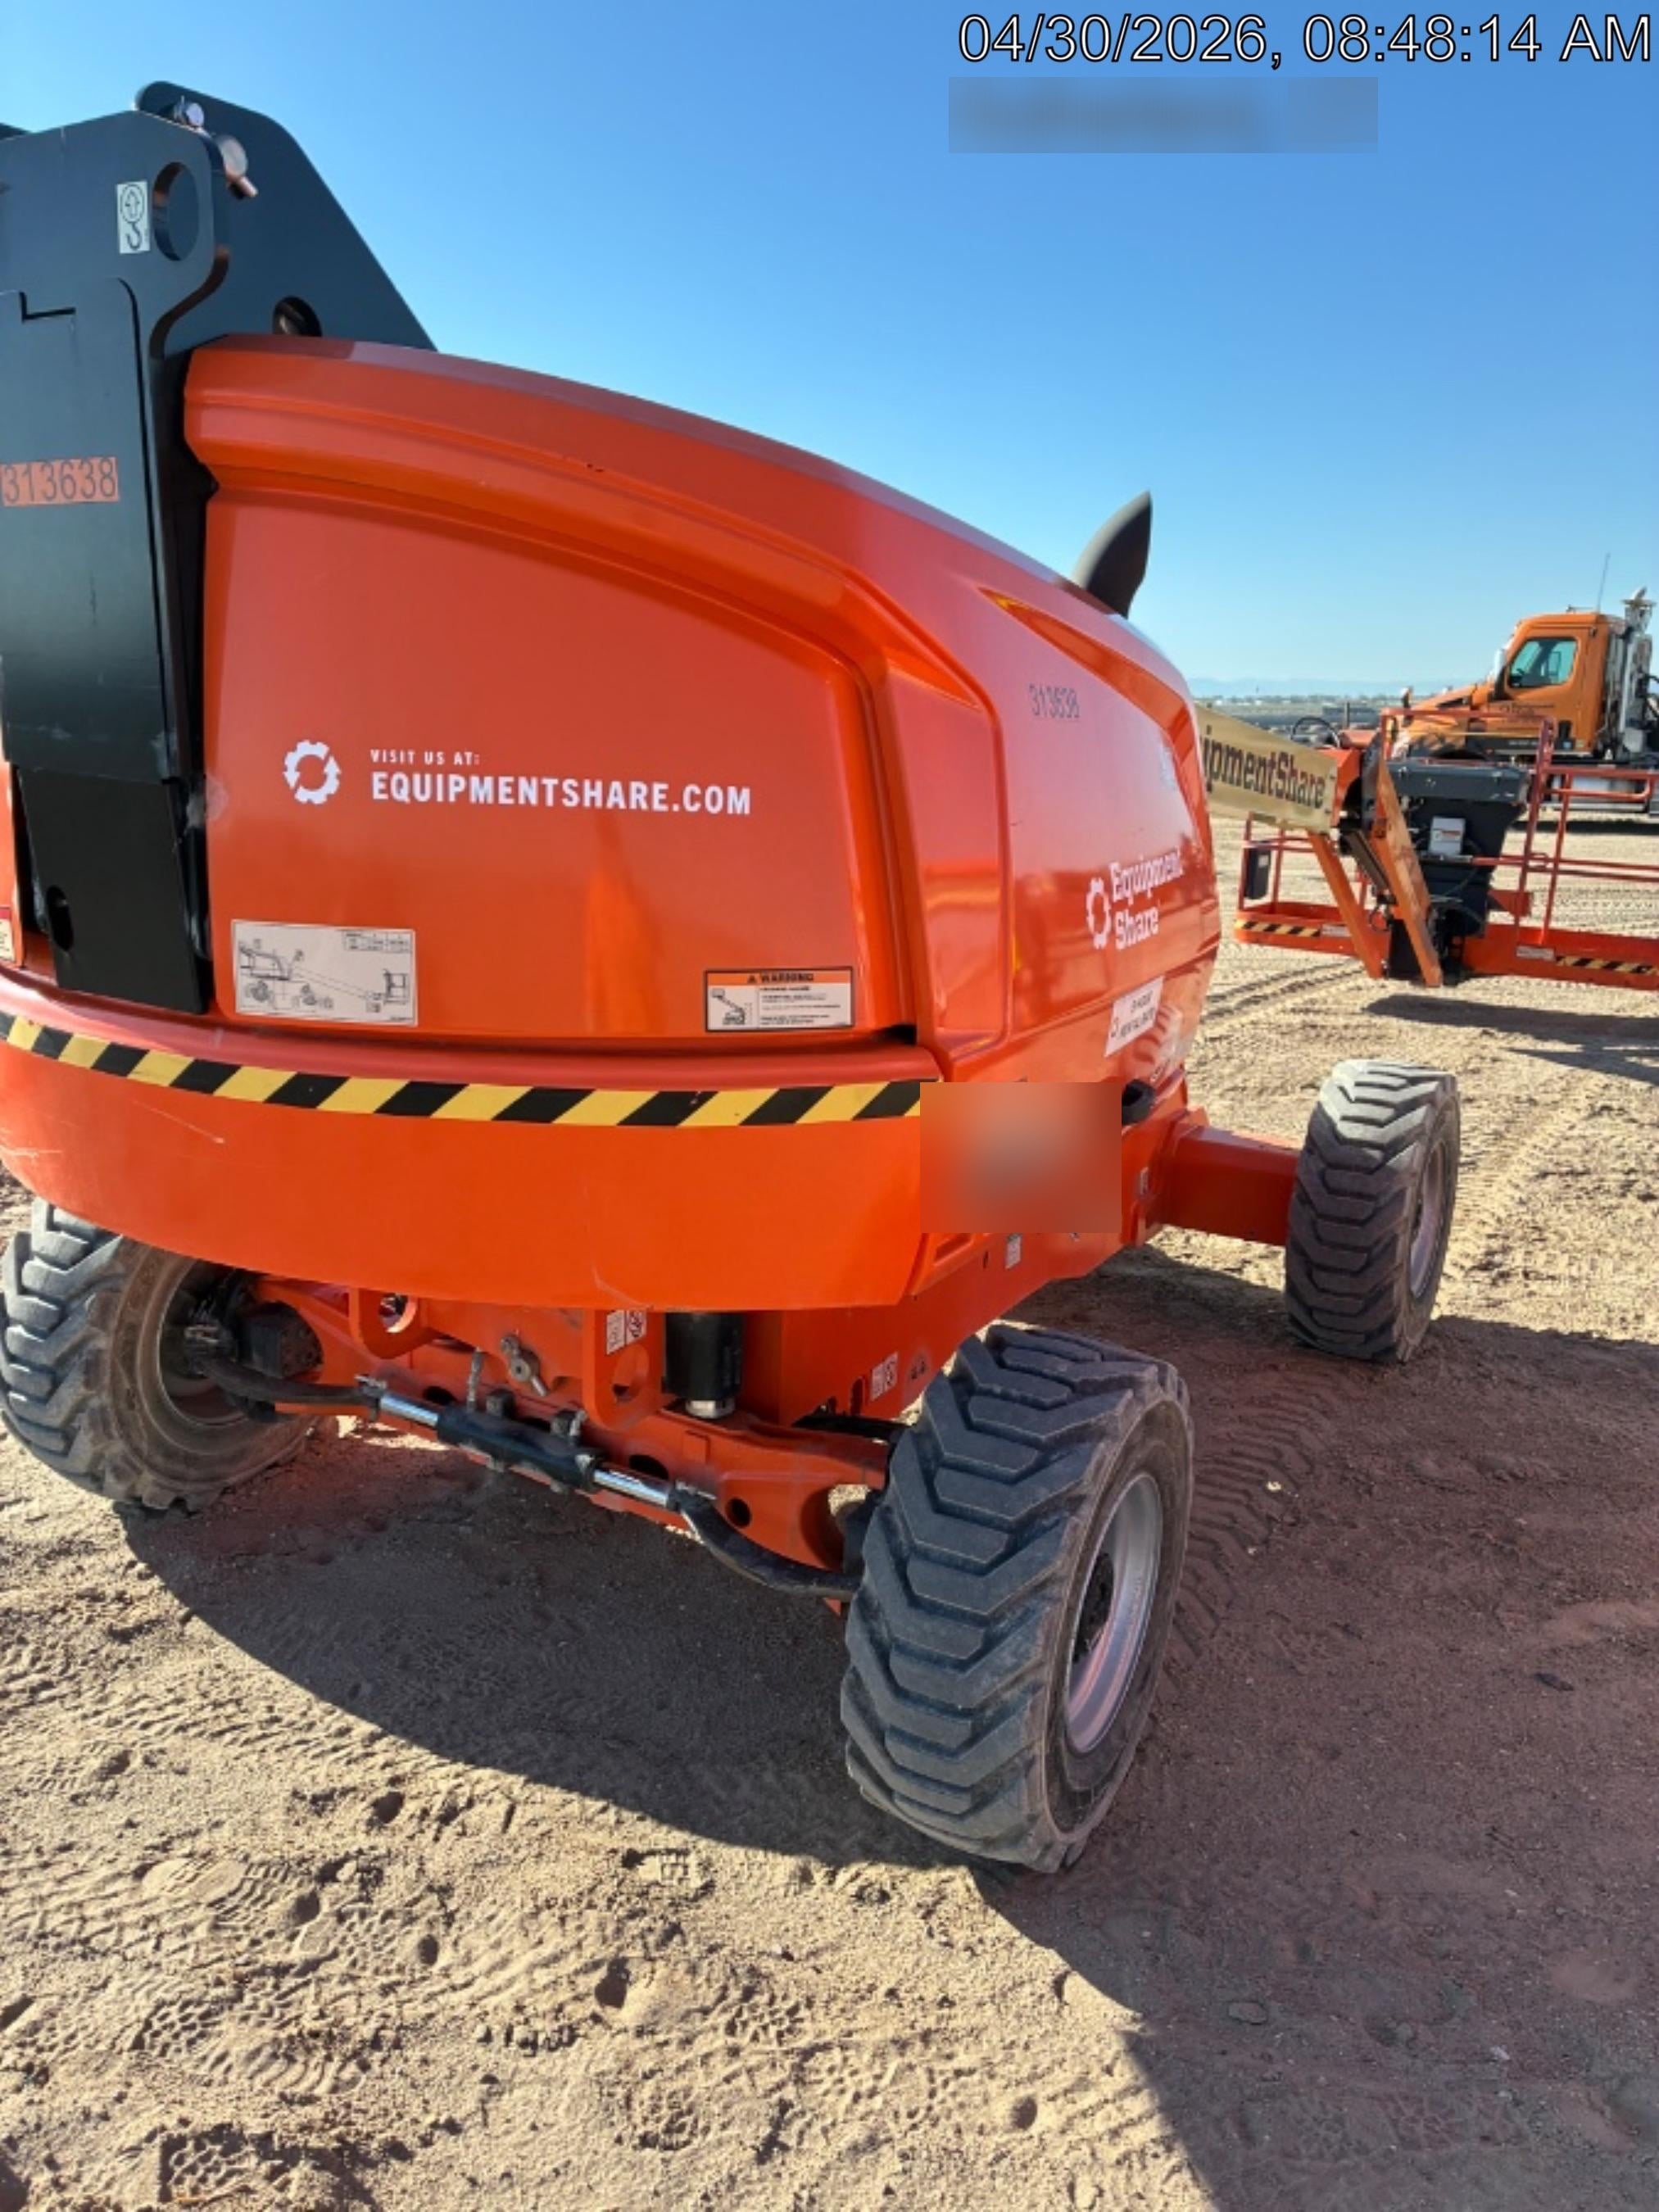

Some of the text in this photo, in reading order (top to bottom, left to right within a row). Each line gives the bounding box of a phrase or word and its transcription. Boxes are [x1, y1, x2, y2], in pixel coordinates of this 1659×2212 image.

[3, 457, 116, 502] 313638
[1027, 683, 1080, 719] 313638
[369, 748, 481, 767] VISIT US AT:
[1200, 724, 1326, 809] ipmentShare
[371, 770, 751, 815] EQUIPMENTSHARE.COM
[1109, 845, 1184, 906] Equipment
[1115, 906, 1158, 950] Share
